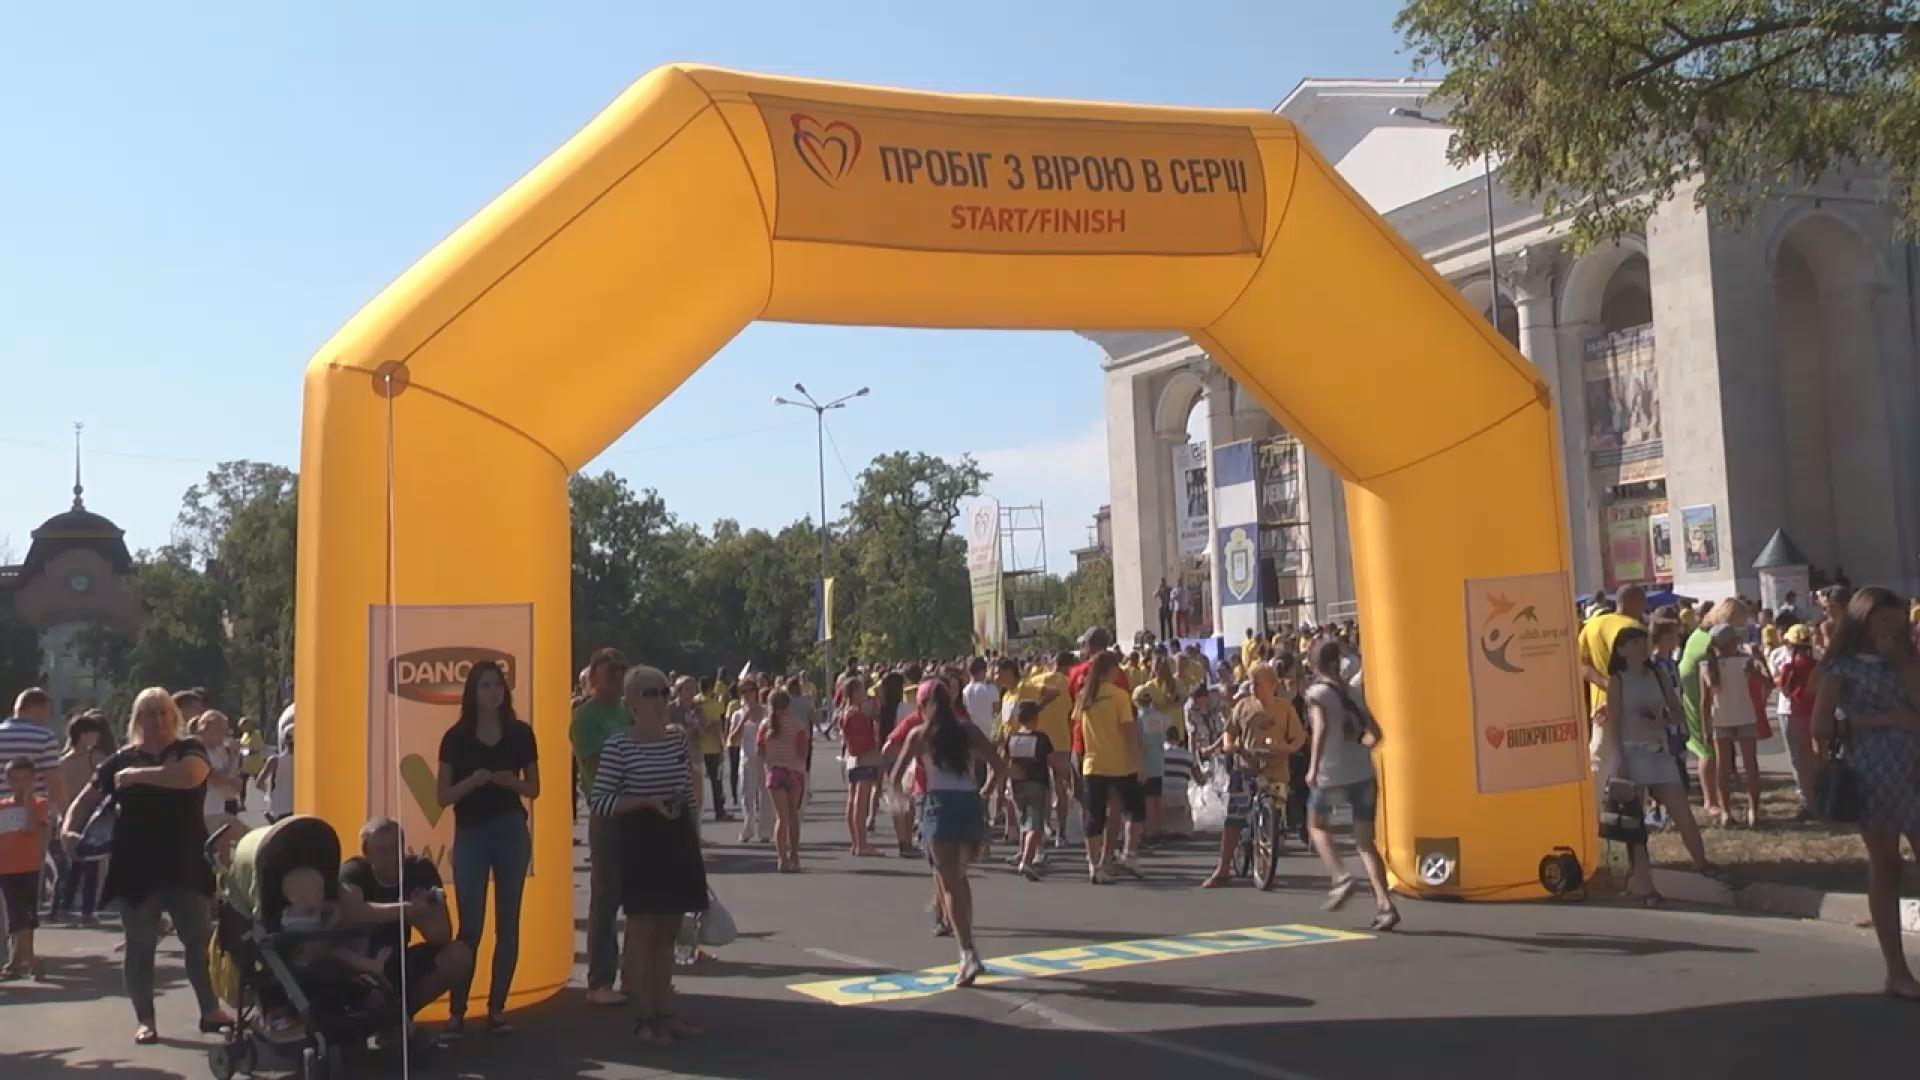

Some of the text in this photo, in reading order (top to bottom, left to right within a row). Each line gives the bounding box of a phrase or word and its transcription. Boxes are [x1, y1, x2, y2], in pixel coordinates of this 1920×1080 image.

[878, 145, 1248, 195] ПРОБІГ З ВІРОЮ В СЕРЦІ
[950, 204, 1127, 235] START/FINISH
[398, 659, 510, 685] DANO
